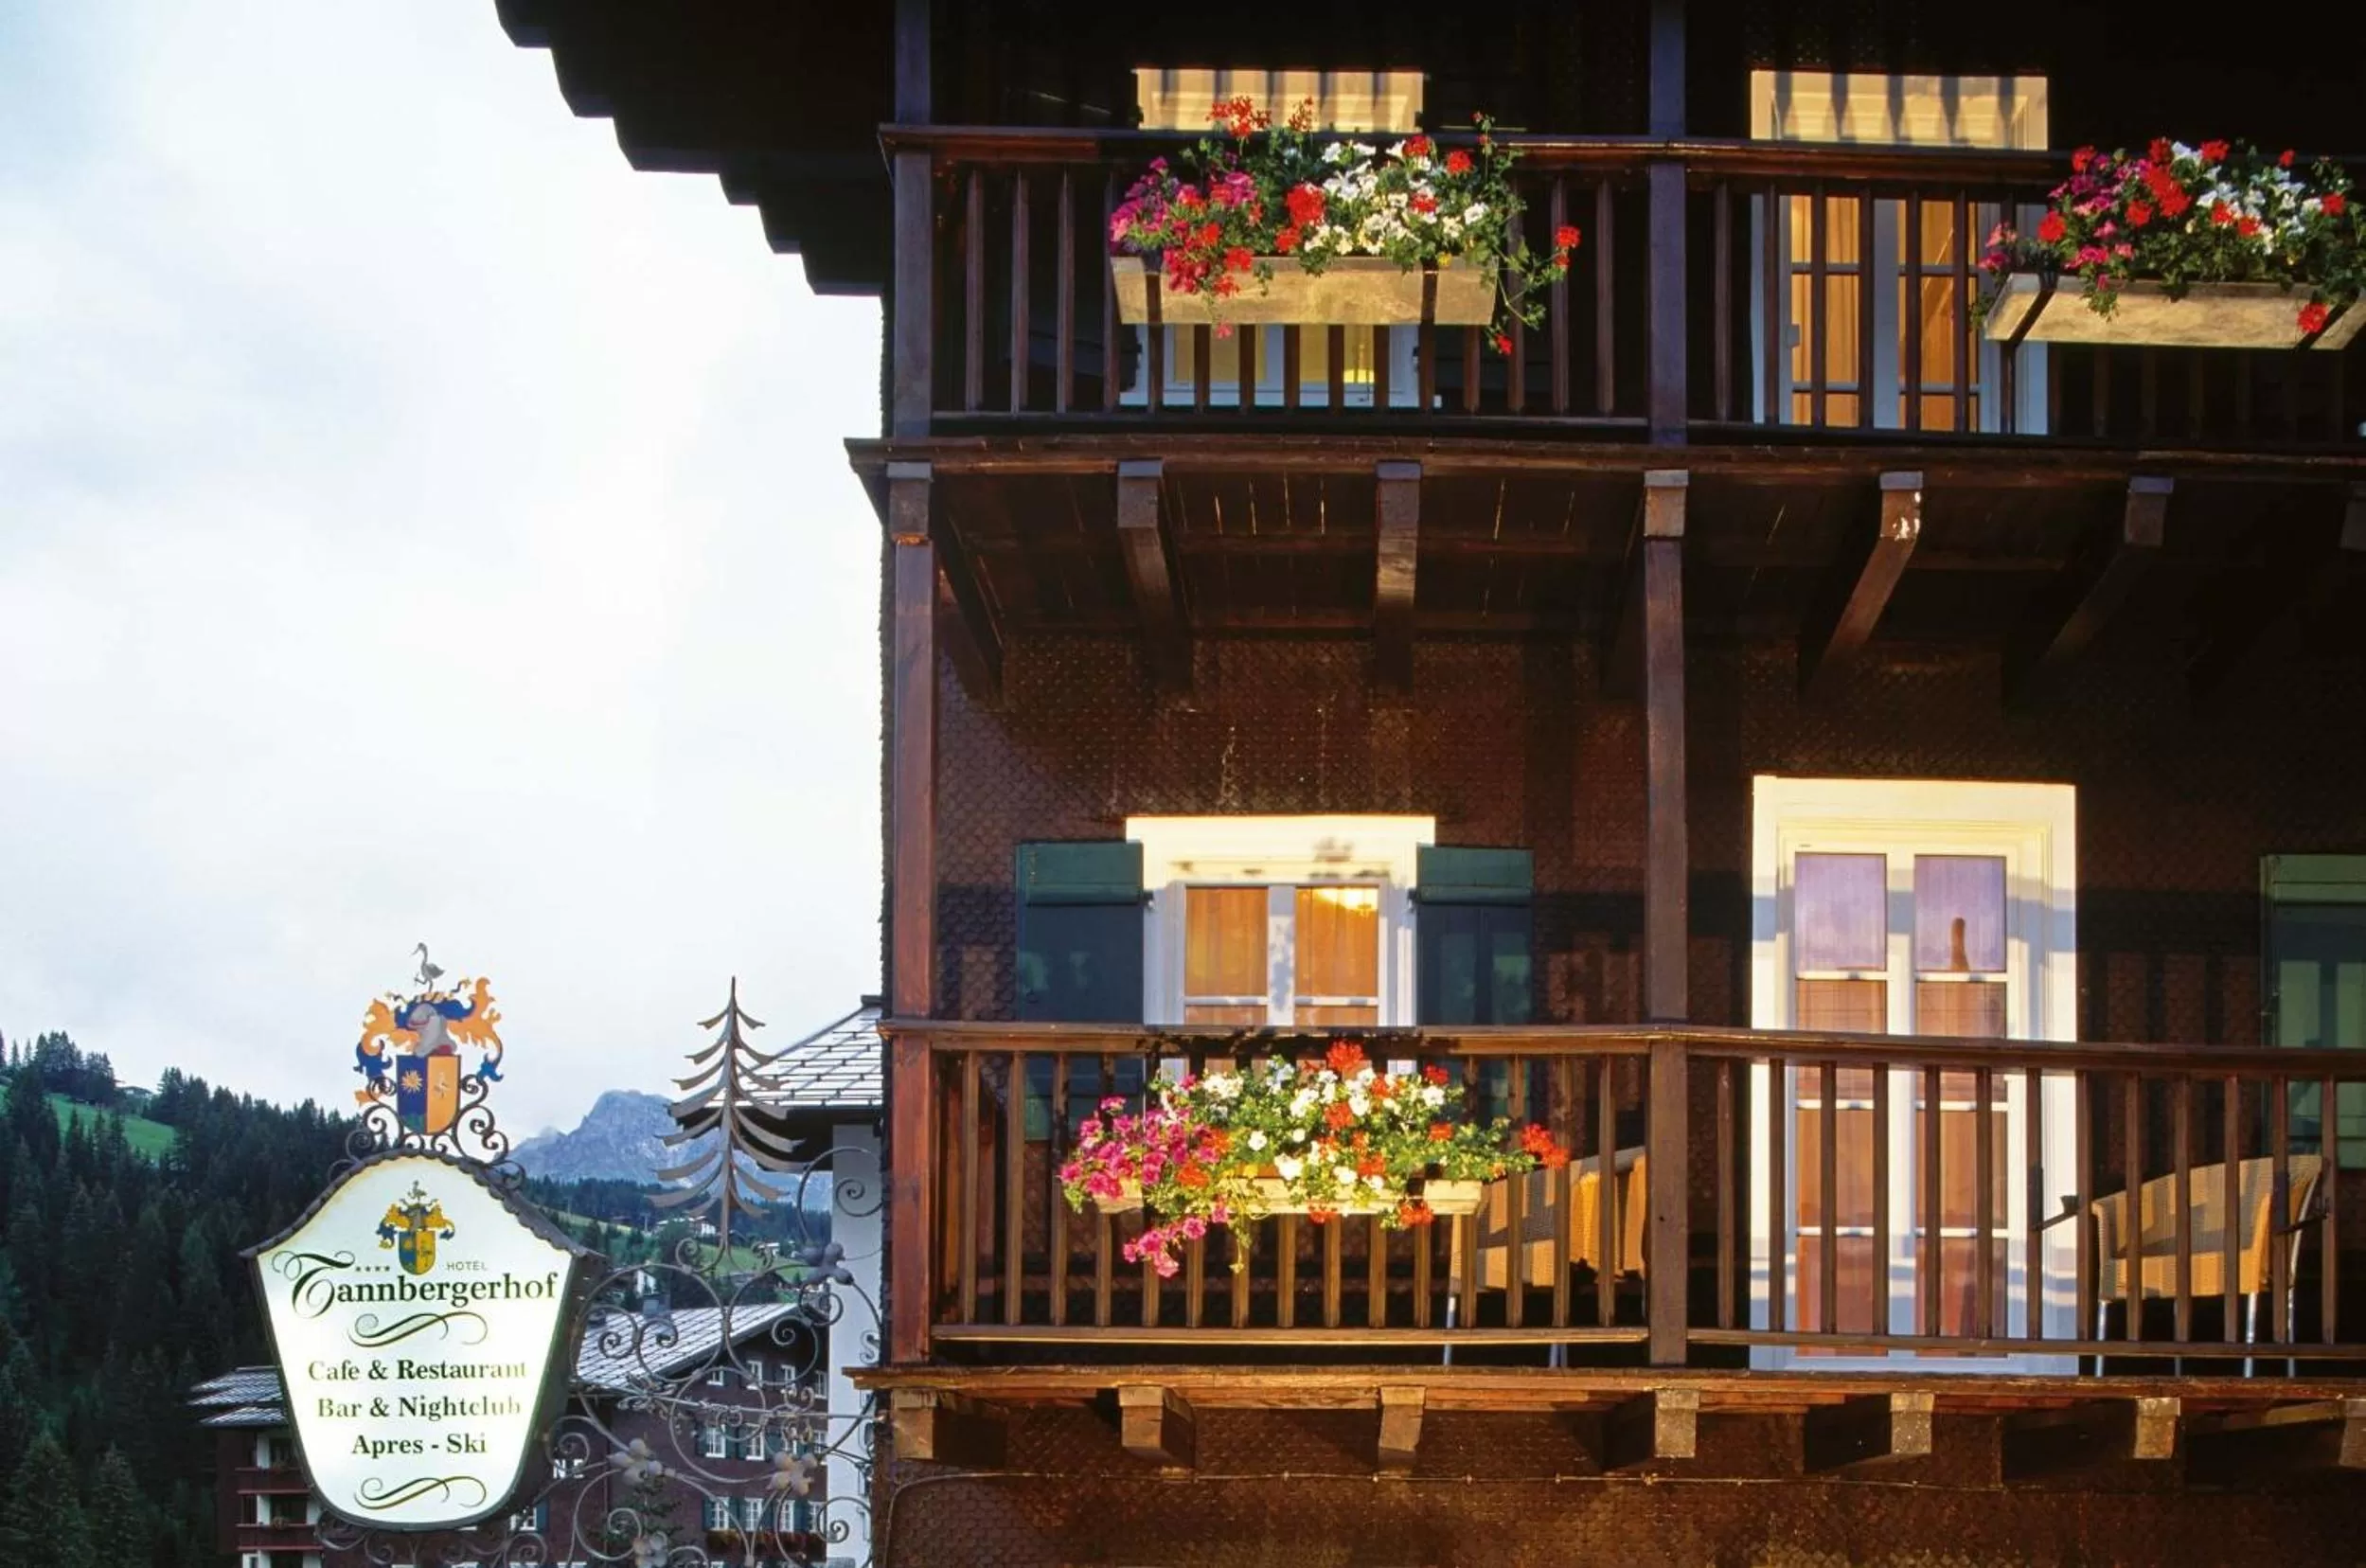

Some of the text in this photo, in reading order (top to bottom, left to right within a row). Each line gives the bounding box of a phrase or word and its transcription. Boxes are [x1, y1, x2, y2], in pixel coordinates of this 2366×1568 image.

[445, 1260, 488, 1272] HOTEL
[272, 1250, 559, 1319] Tannbergerhof
[308, 1358, 527, 1381] Cafe & Restaurant
[318, 1395, 522, 1422] Bar & Nightclub
[351, 1434, 424, 1457] Apres
[446, 1432, 487, 1454] Ski
